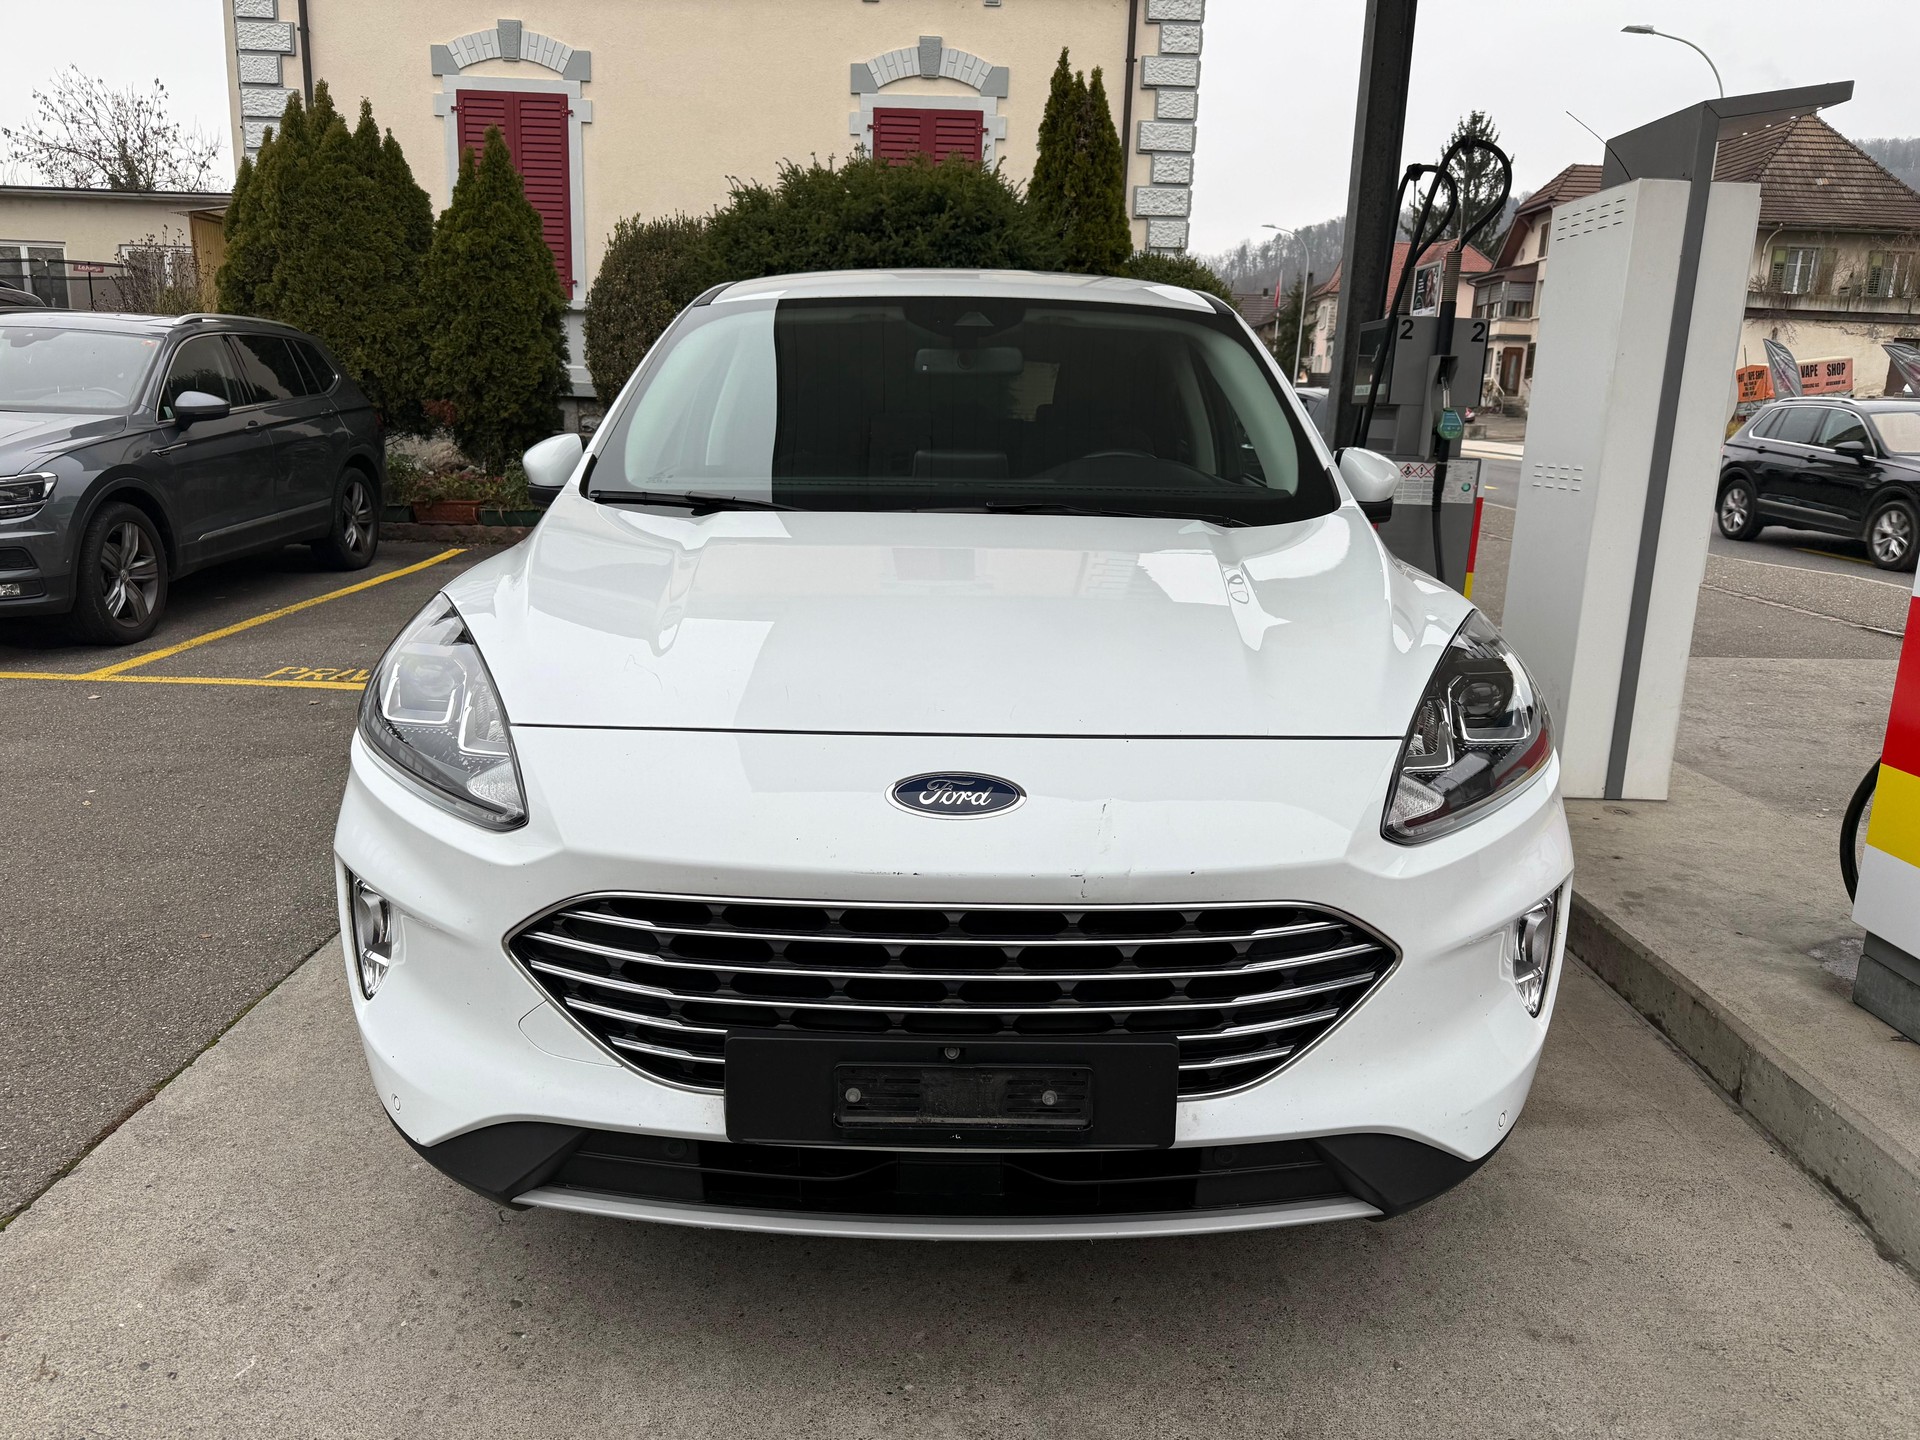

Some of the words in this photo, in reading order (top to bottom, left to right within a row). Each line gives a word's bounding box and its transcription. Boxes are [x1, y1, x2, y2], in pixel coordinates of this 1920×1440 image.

[1400, 319, 1414, 340] 2
[1471, 322, 1485, 342] 2
[1800, 364, 1818, 378] VAPE
[1826, 362, 1846, 376] SHOP
[918, 779, 993, 806] Ford
